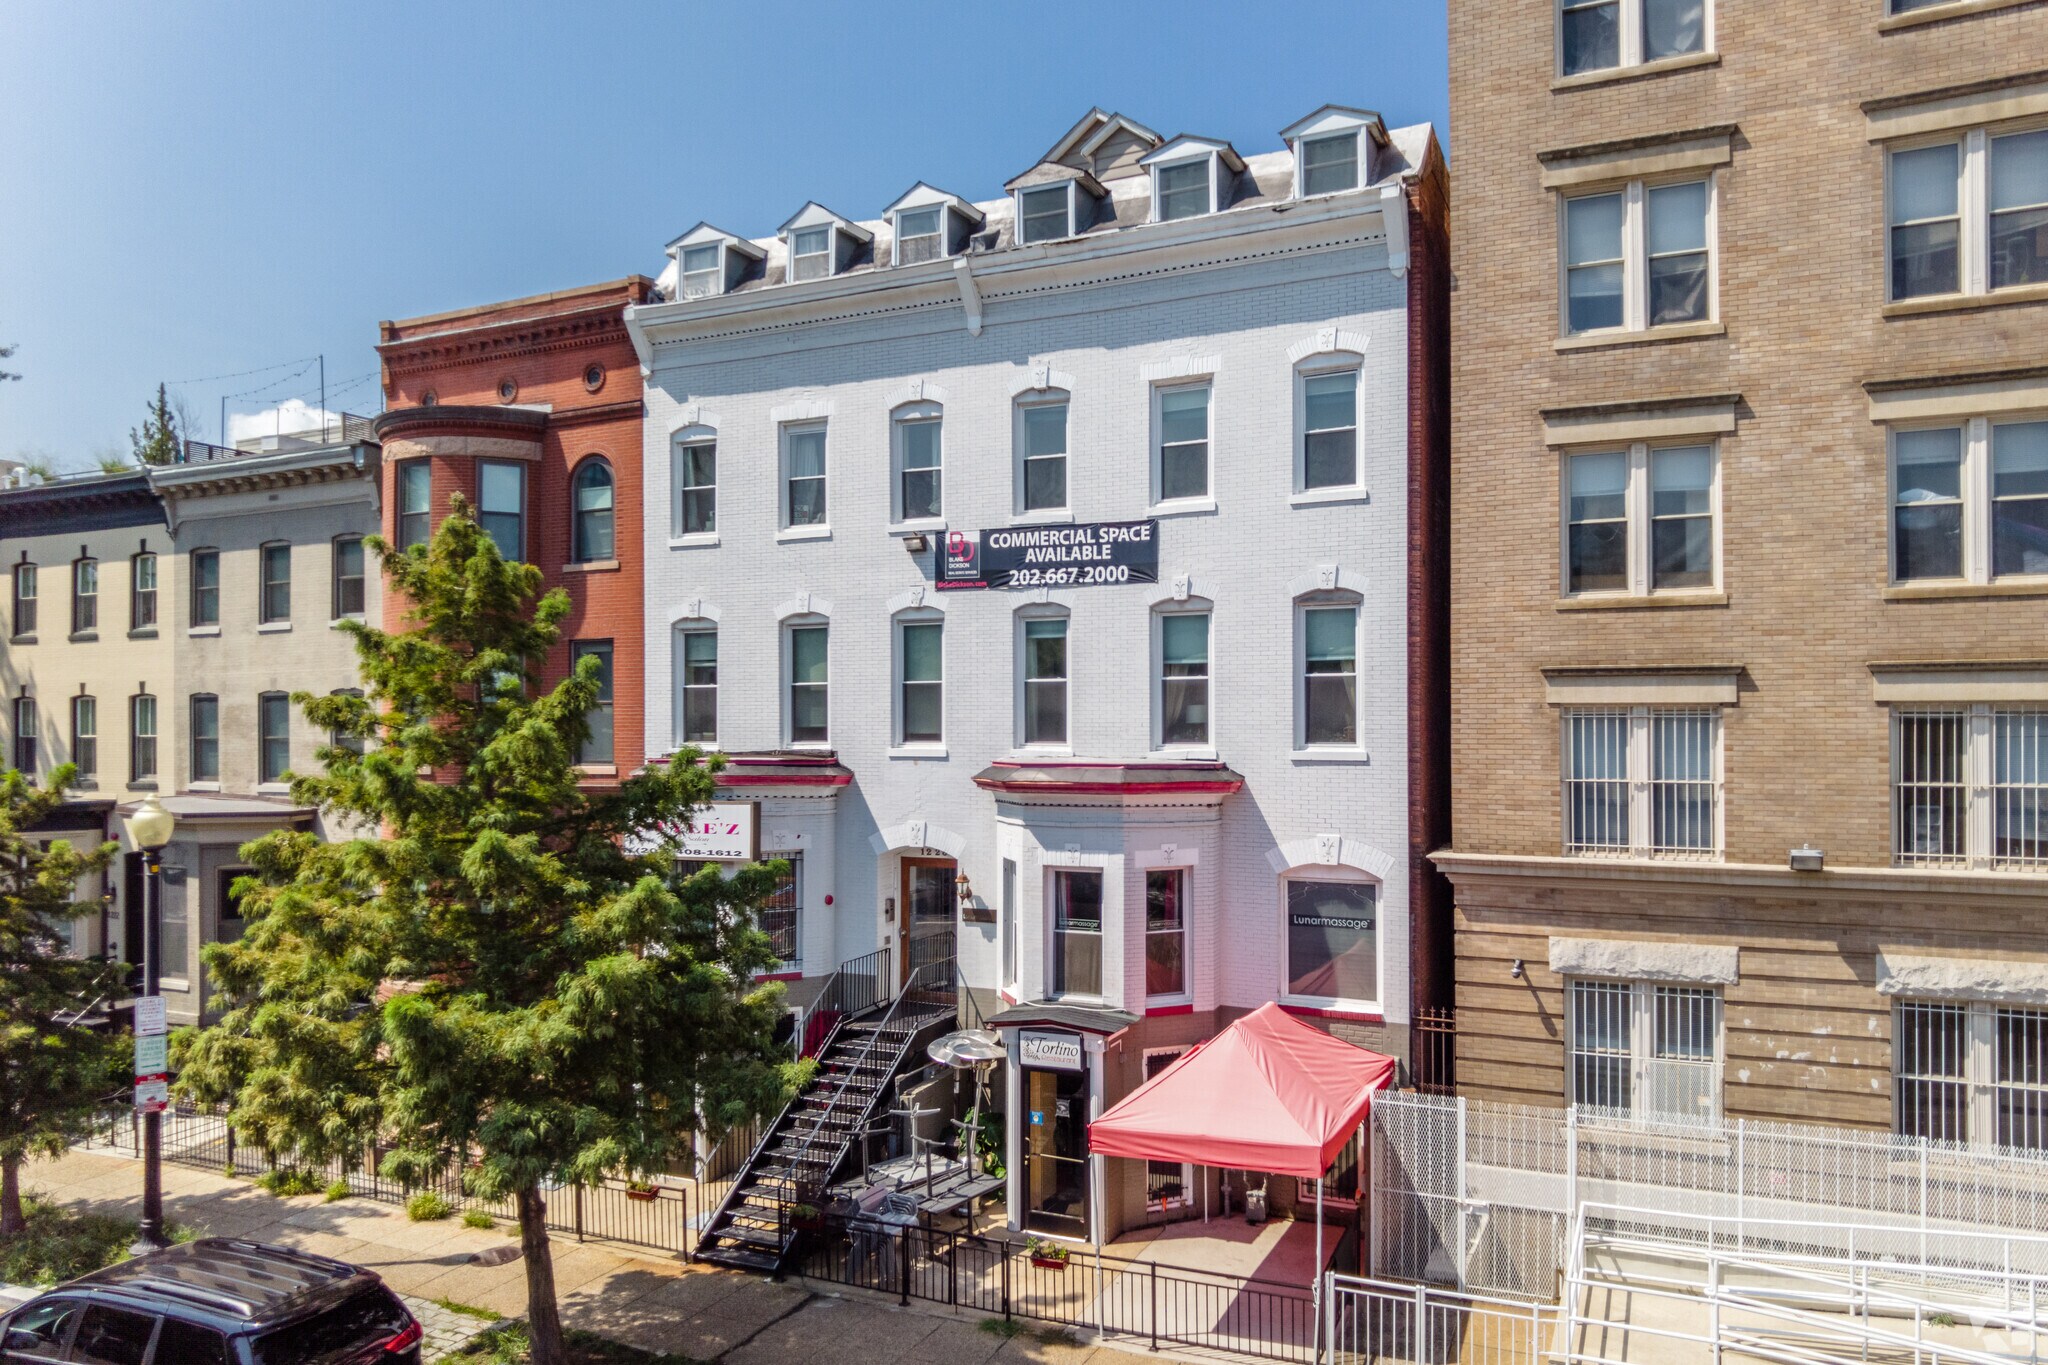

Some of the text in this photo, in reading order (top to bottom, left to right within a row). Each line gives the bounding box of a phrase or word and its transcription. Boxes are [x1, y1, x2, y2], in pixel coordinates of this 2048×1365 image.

[989, 525, 1151, 549] COMMERCIAL SPACE
[1025, 544, 1112, 563] AVAILABLE
[1009, 565, 1129, 586] 202.667.2000
[1293, 914, 1368, 930] Lunarmassage
[1030, 1036, 1079, 1057] Tortino
